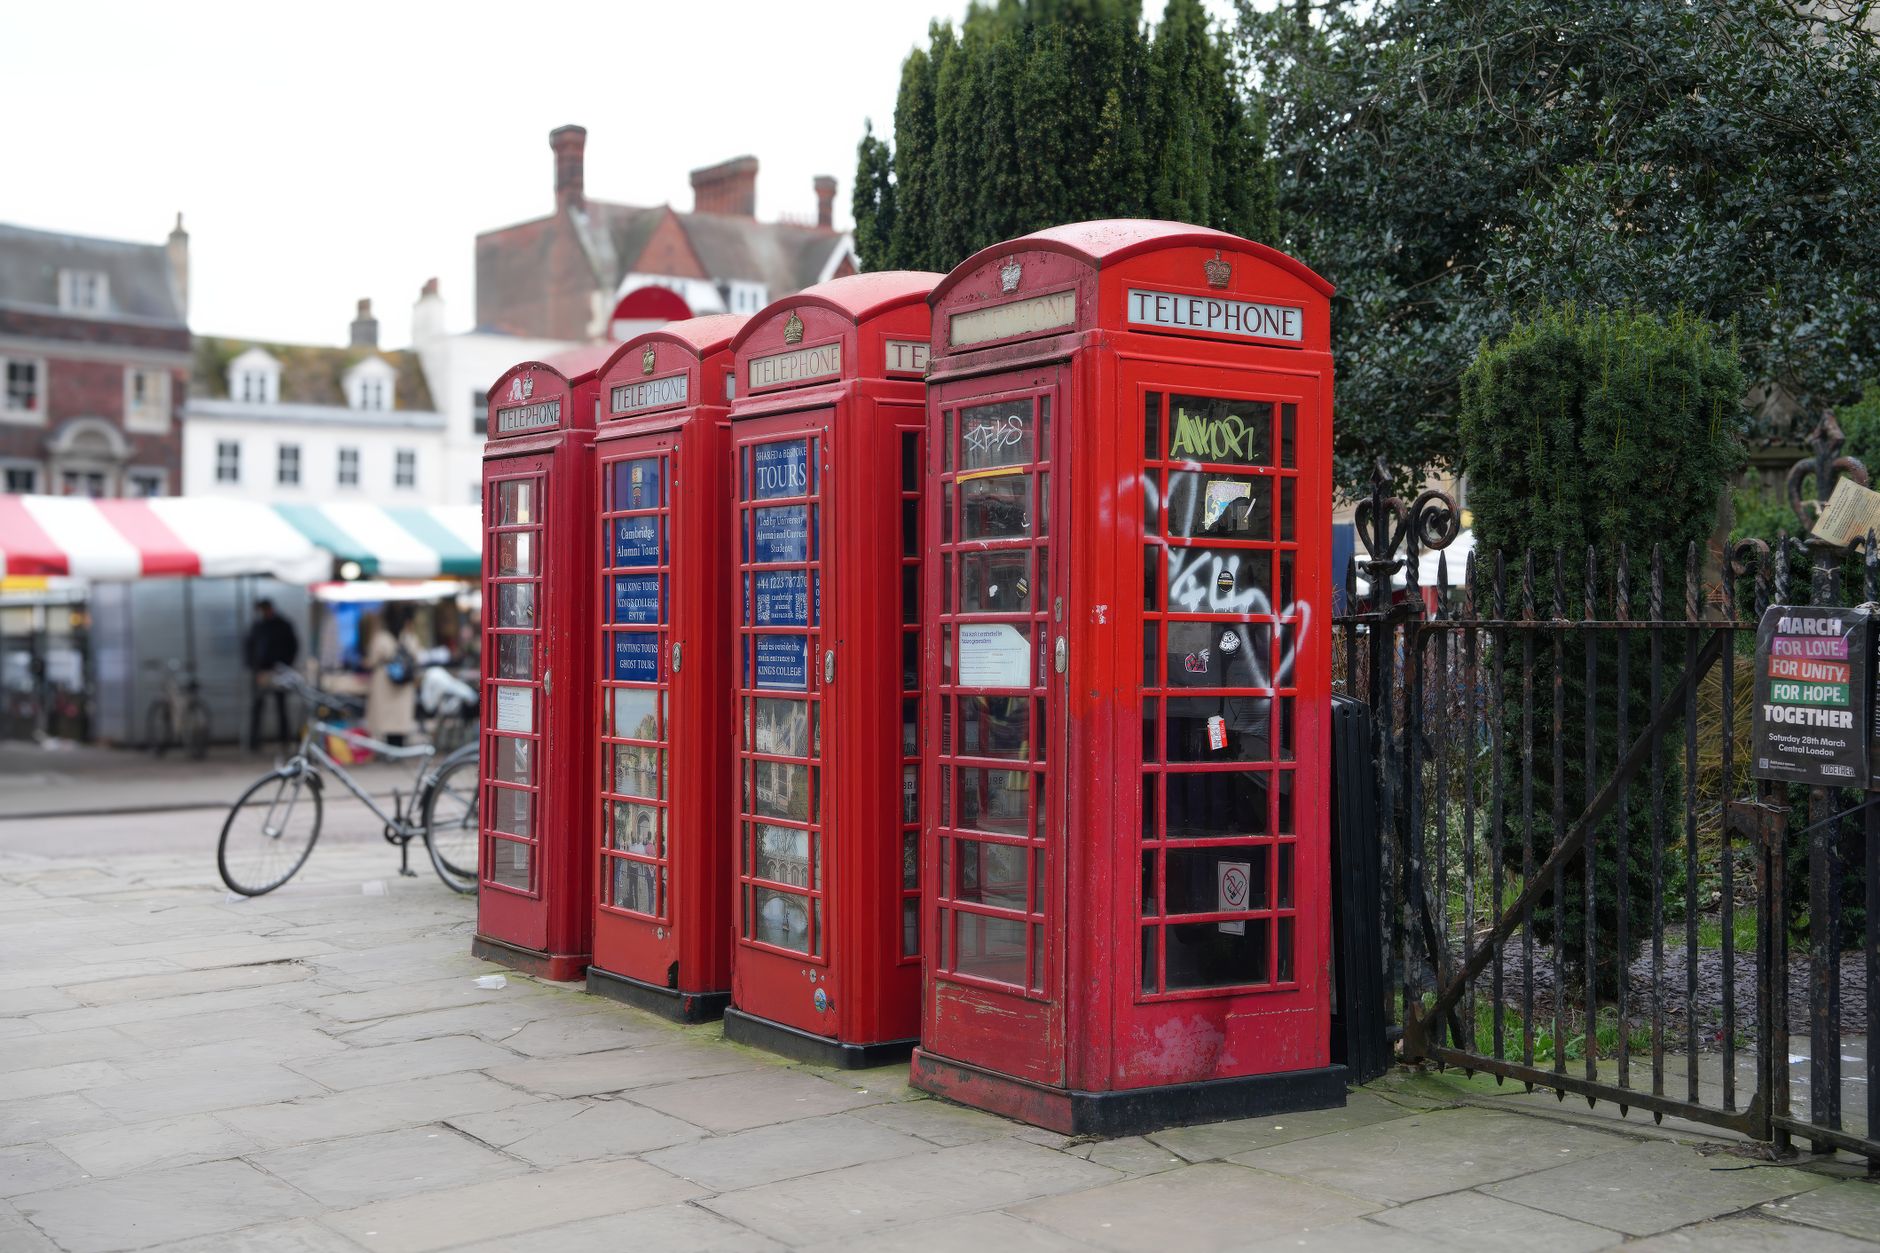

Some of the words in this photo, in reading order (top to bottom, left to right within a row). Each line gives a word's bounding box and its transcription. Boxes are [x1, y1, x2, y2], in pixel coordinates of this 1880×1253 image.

[1133, 292, 1296, 337] TELEPHONE
[753, 347, 839, 385] TELEPHONE
[615, 377, 687, 410] TELEPHONE
[500, 402, 561, 432] TELEPHONE
[757, 462, 807, 490] TOURS
[621, 525, 655, 541] Cambridge
[617, 544, 641, 557] Alumni
[641, 543, 659, 556] Tours
[1777, 616, 1842, 636] MARCH
[616, 643, 641, 653] PUNTING
[641, 643, 659, 653] TOURS
[1775, 640, 1802, 656] FOR
[1805, 640, 1844, 657] LOVE.
[620, 659, 637, 669] GHOST
[637, 659, 656, 670] TOURS
[776, 666, 802, 677] COLLEGE
[1772, 659, 1799, 676] FOR
[1801, 662, 1847, 683] UNITY.
[1774, 684, 1800, 700] FOR
[1803, 685, 1845, 703] HOPE.
[1763, 704, 1854, 729] TOGETHER
[1768, 732, 1801, 745] Saturday
[1801, 736, 1820, 745] 28th
[1820, 737, 1846, 747] March
[1778, 744, 1805, 754] Central
[1806, 749, 1835, 757] London
